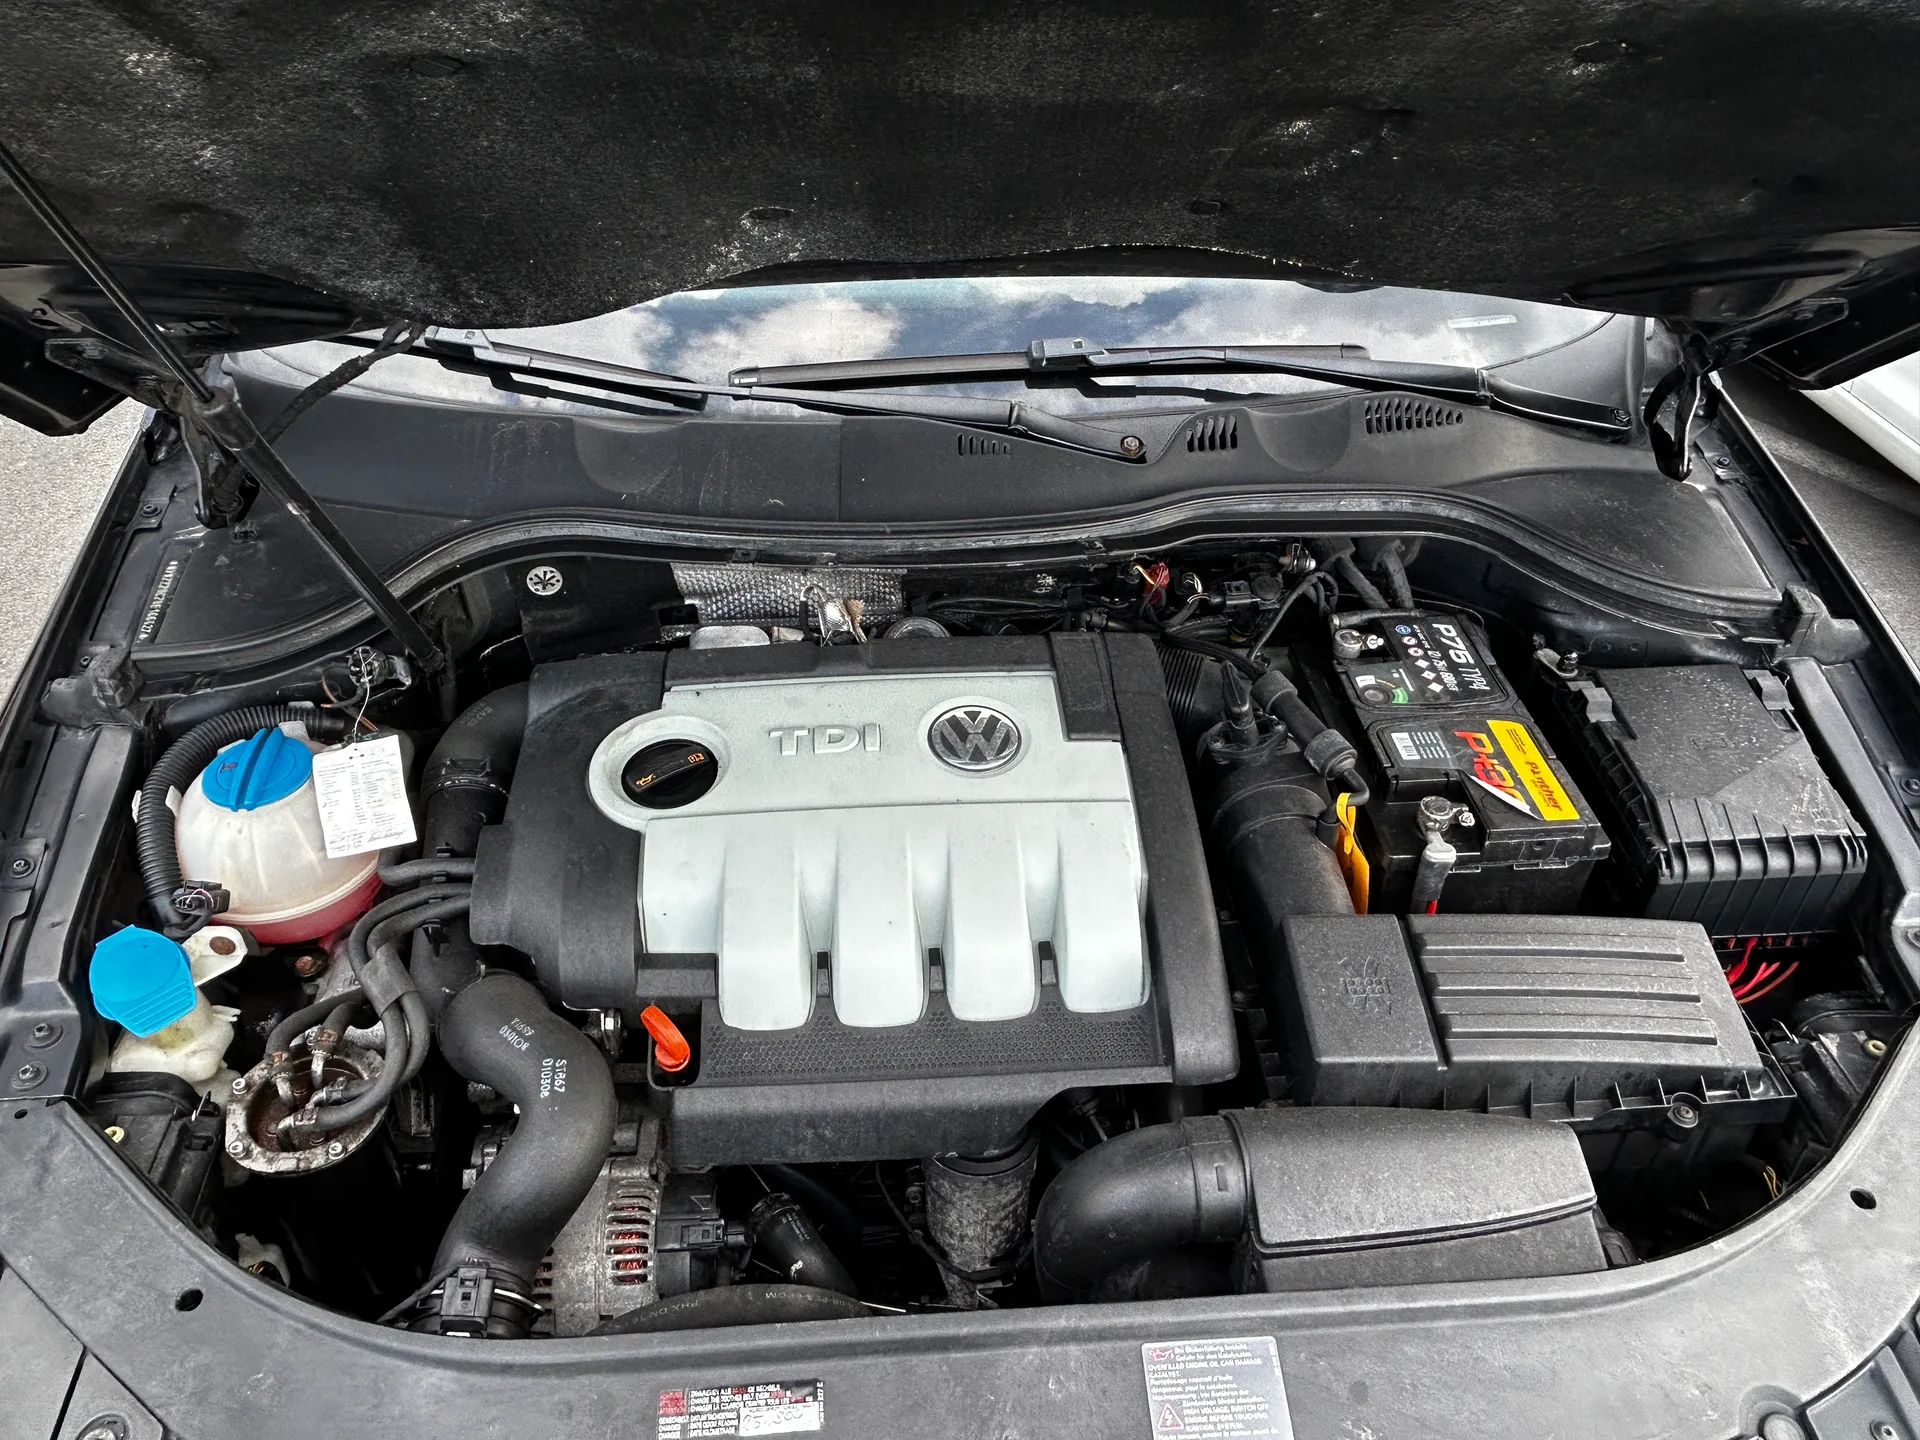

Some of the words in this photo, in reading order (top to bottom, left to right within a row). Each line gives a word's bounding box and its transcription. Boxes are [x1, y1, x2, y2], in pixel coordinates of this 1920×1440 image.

[1432, 623, 1475, 664] P75
[768, 722, 882, 757] TDI
[928, 705, 1021, 771] VW
